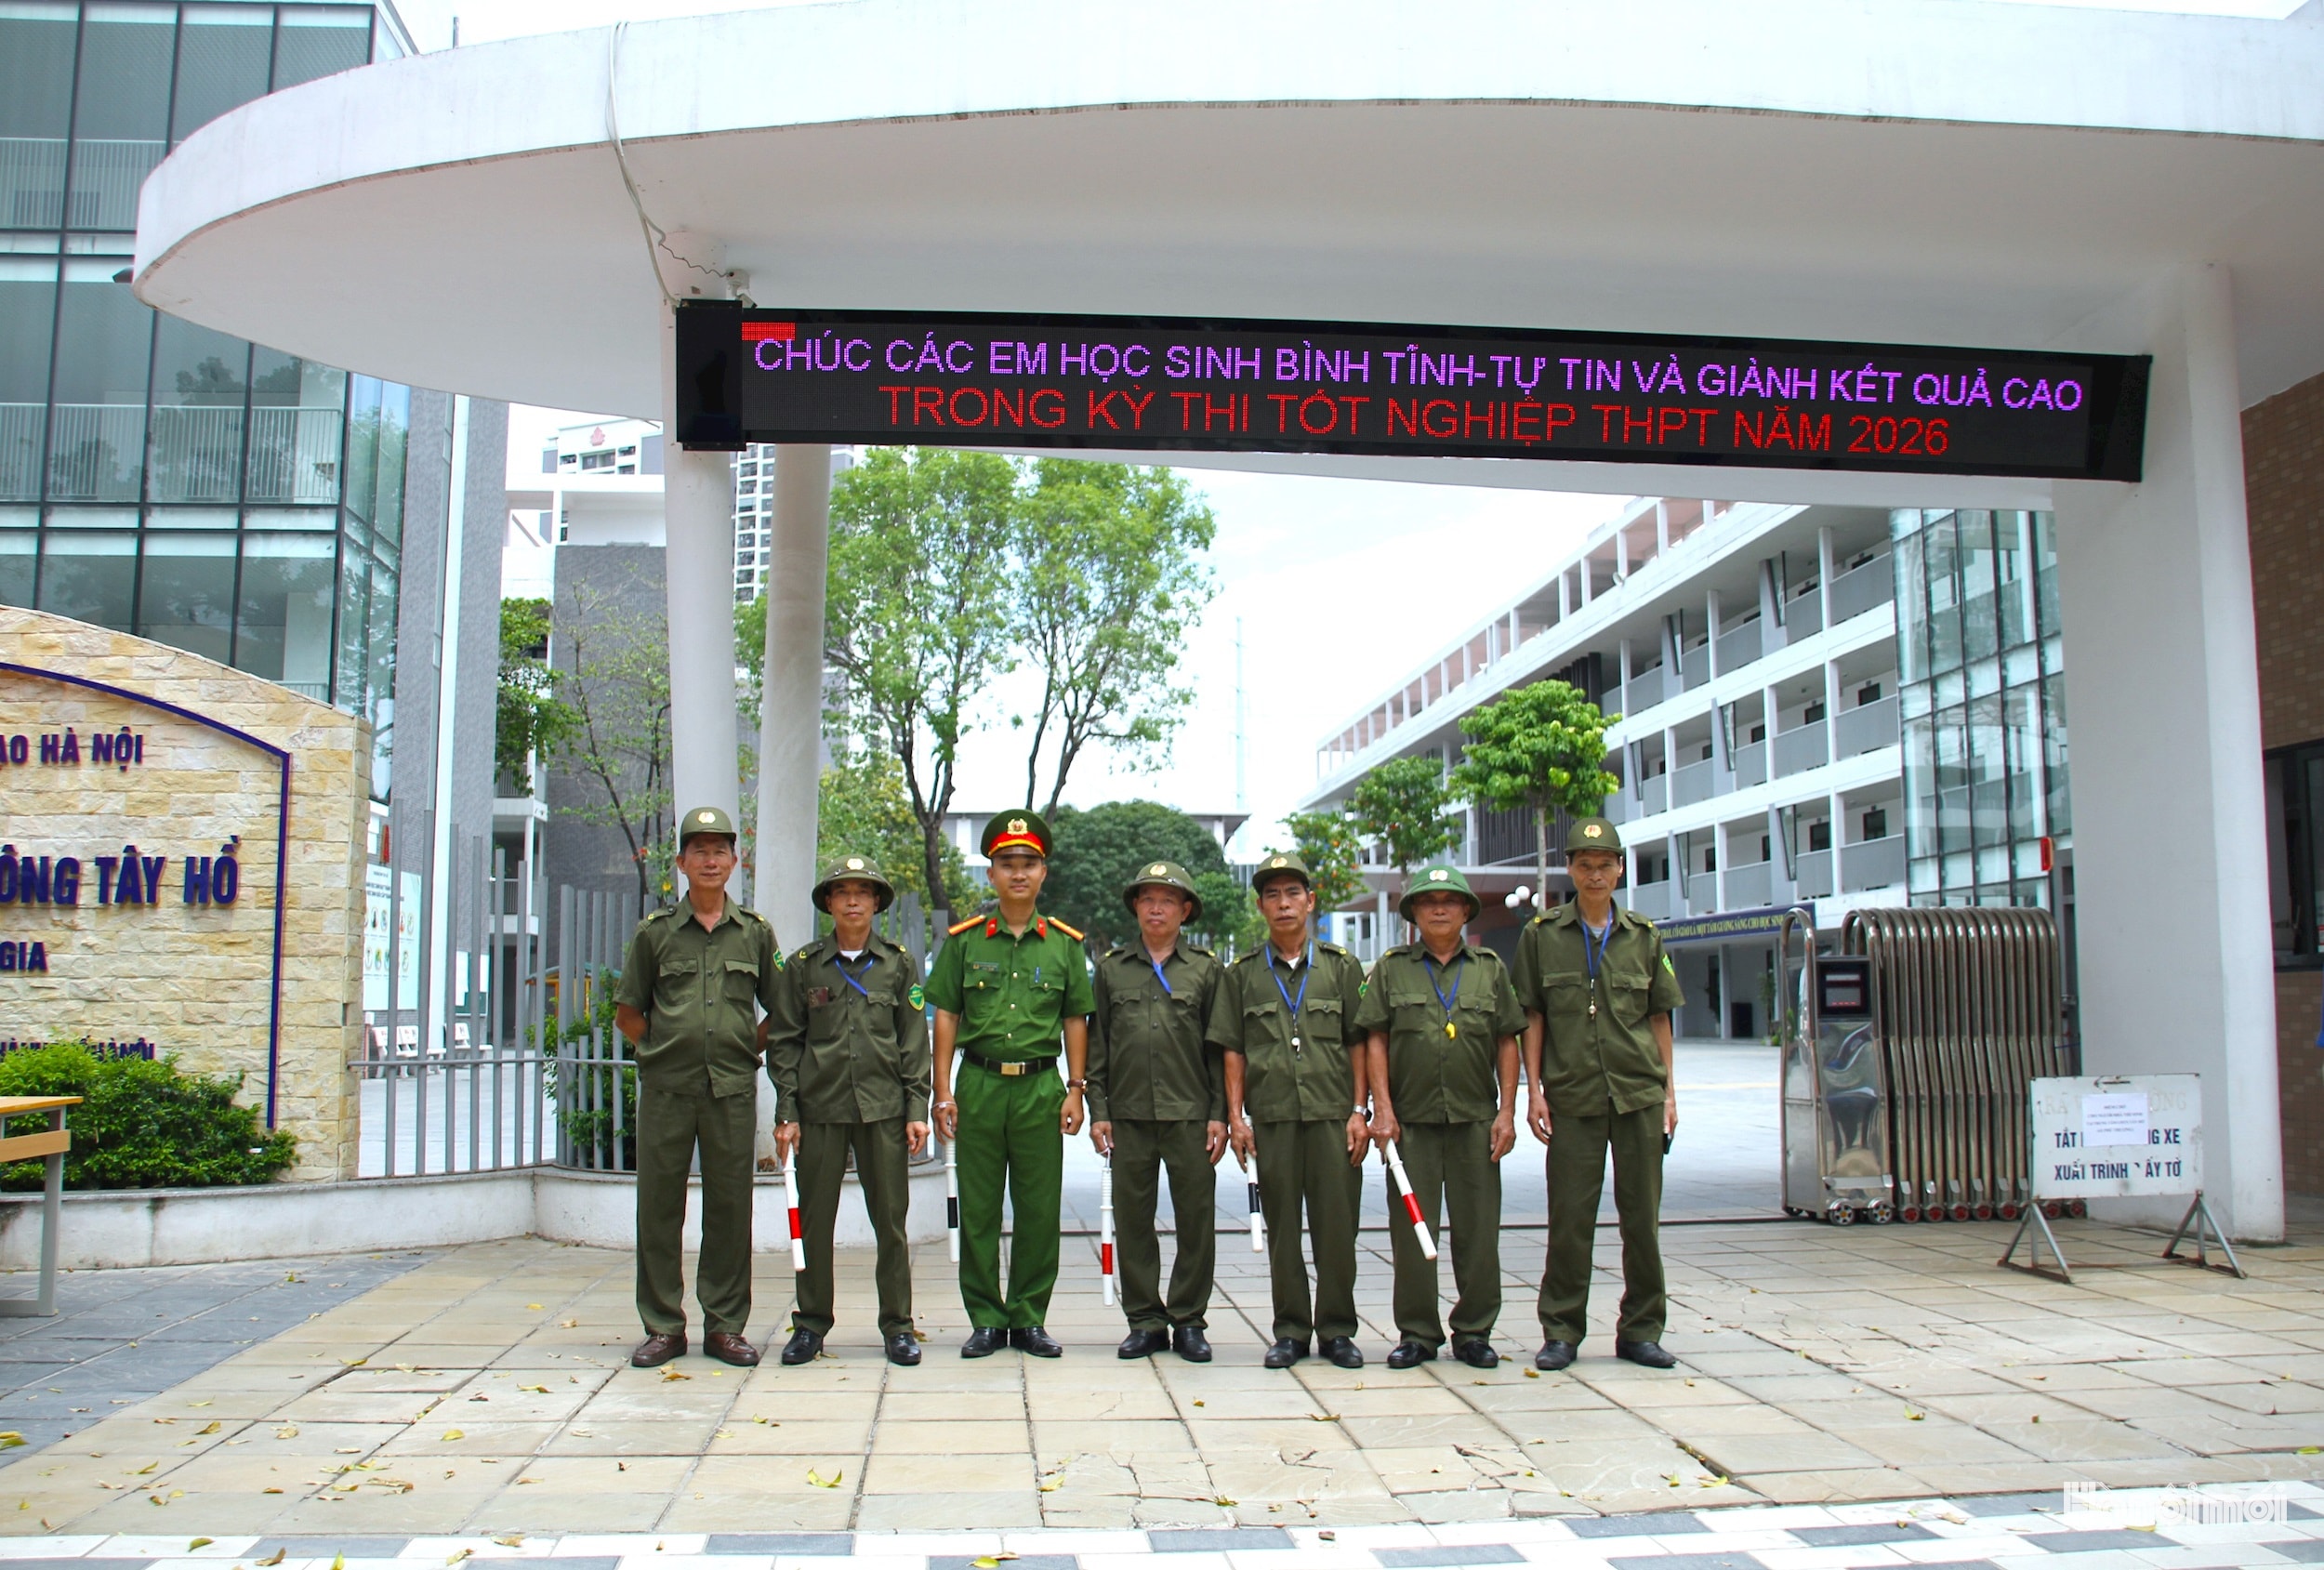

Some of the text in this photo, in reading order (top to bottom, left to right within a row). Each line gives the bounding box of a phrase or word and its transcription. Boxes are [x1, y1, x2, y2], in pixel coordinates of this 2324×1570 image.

[755, 329, 872, 372] CHÚC
[885, 331, 973, 373] CÁC
[990, 341, 1047, 375] EM
[1061, 343, 1150, 383] HỌC
[1164, 345, 1261, 379] SINH
[1275, 340, 1369, 383] BÌNH
[1559, 358, 1621, 391] TIN
[1631, 353, 1687, 394] VÀ
[1697, 357, 1817, 401] GIÀNH
[1829, 362, 1903, 402] KẾT
[1912, 367, 1993, 408] QUẢ
[2002, 377, 2083, 411] CAO
[878, 384, 1950, 455] TRONG KỲ THI TỐT NGHIỆP THPT NĂM 2026
[41, 727, 80, 764] HÀ
[93, 726, 143, 772] NỘI
[95, 844, 166, 904] TÂY
[183, 835, 240, 904] HỒ
[0, 941, 48, 971] GIA
[2164, 1128, 2181, 1144] XE
[2091, 1159, 2129, 1180] TRÌNH
[2164, 1156, 2182, 1178] TỜ
